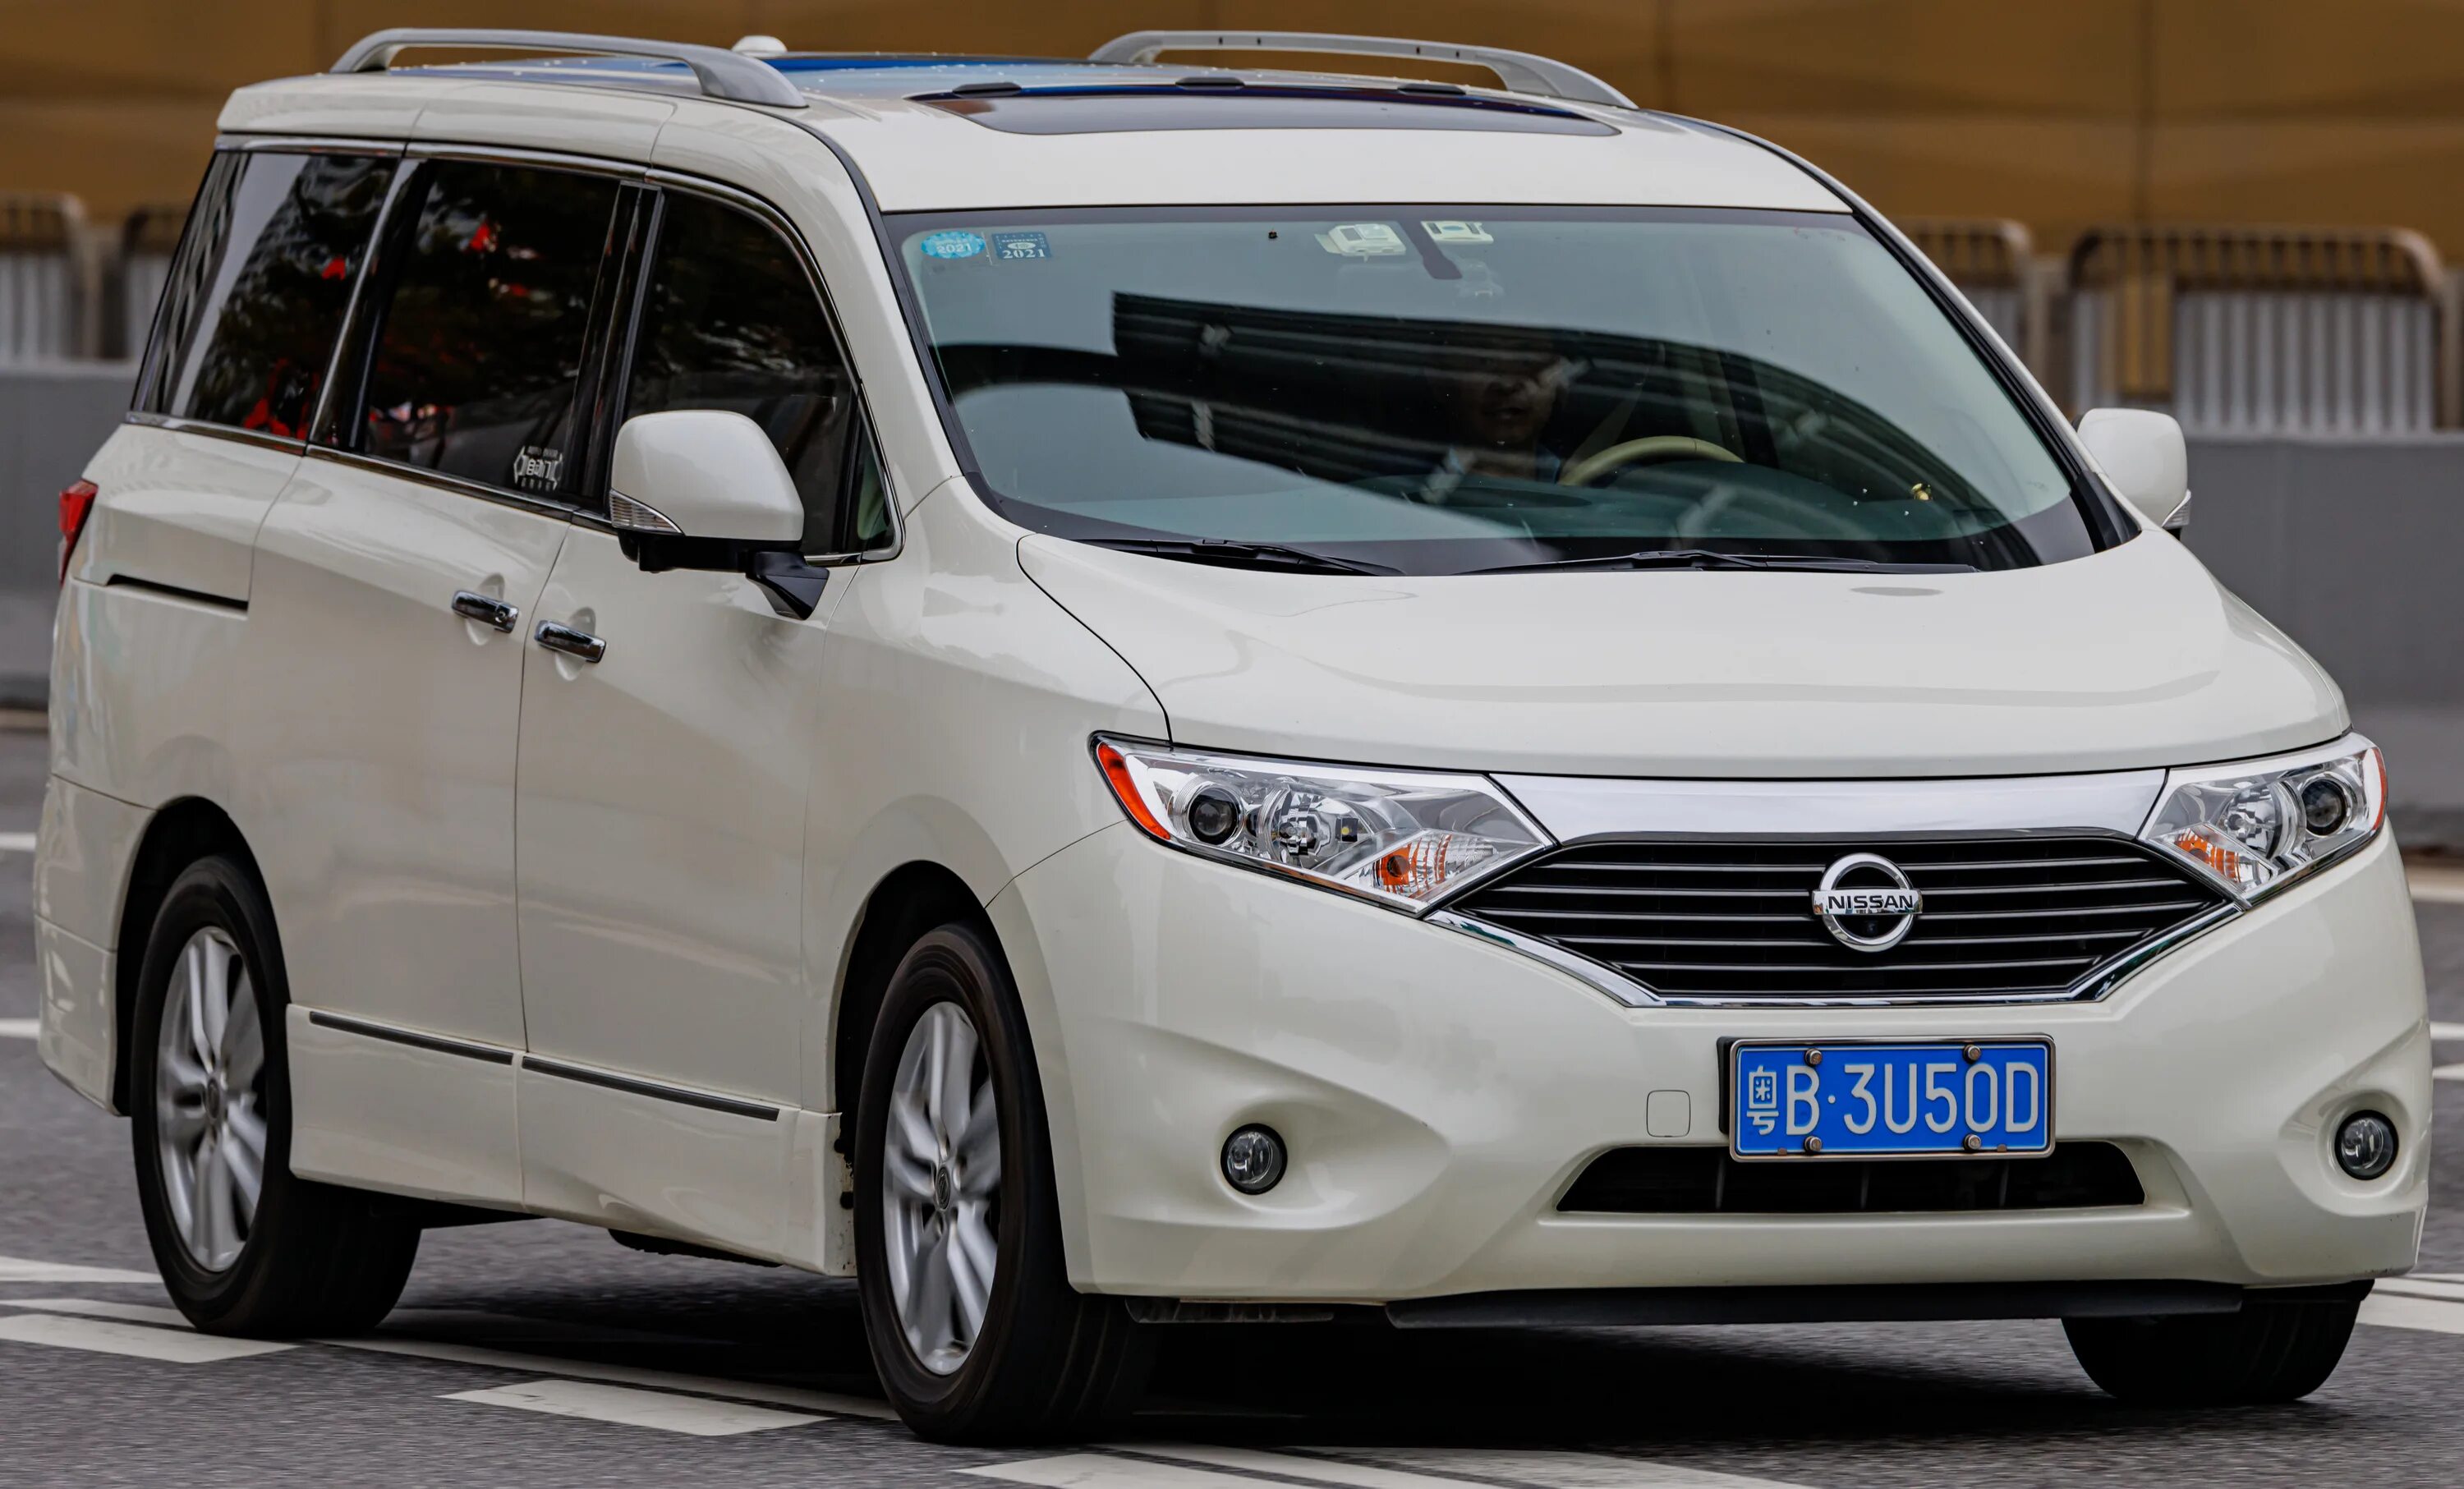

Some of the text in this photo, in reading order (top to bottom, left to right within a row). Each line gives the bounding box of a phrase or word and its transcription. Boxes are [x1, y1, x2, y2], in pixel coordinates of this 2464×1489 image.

[936, 242, 972, 254] 2021
[1002, 249, 1046, 259] 2021
[1827, 894, 1914, 910] NISSAN
